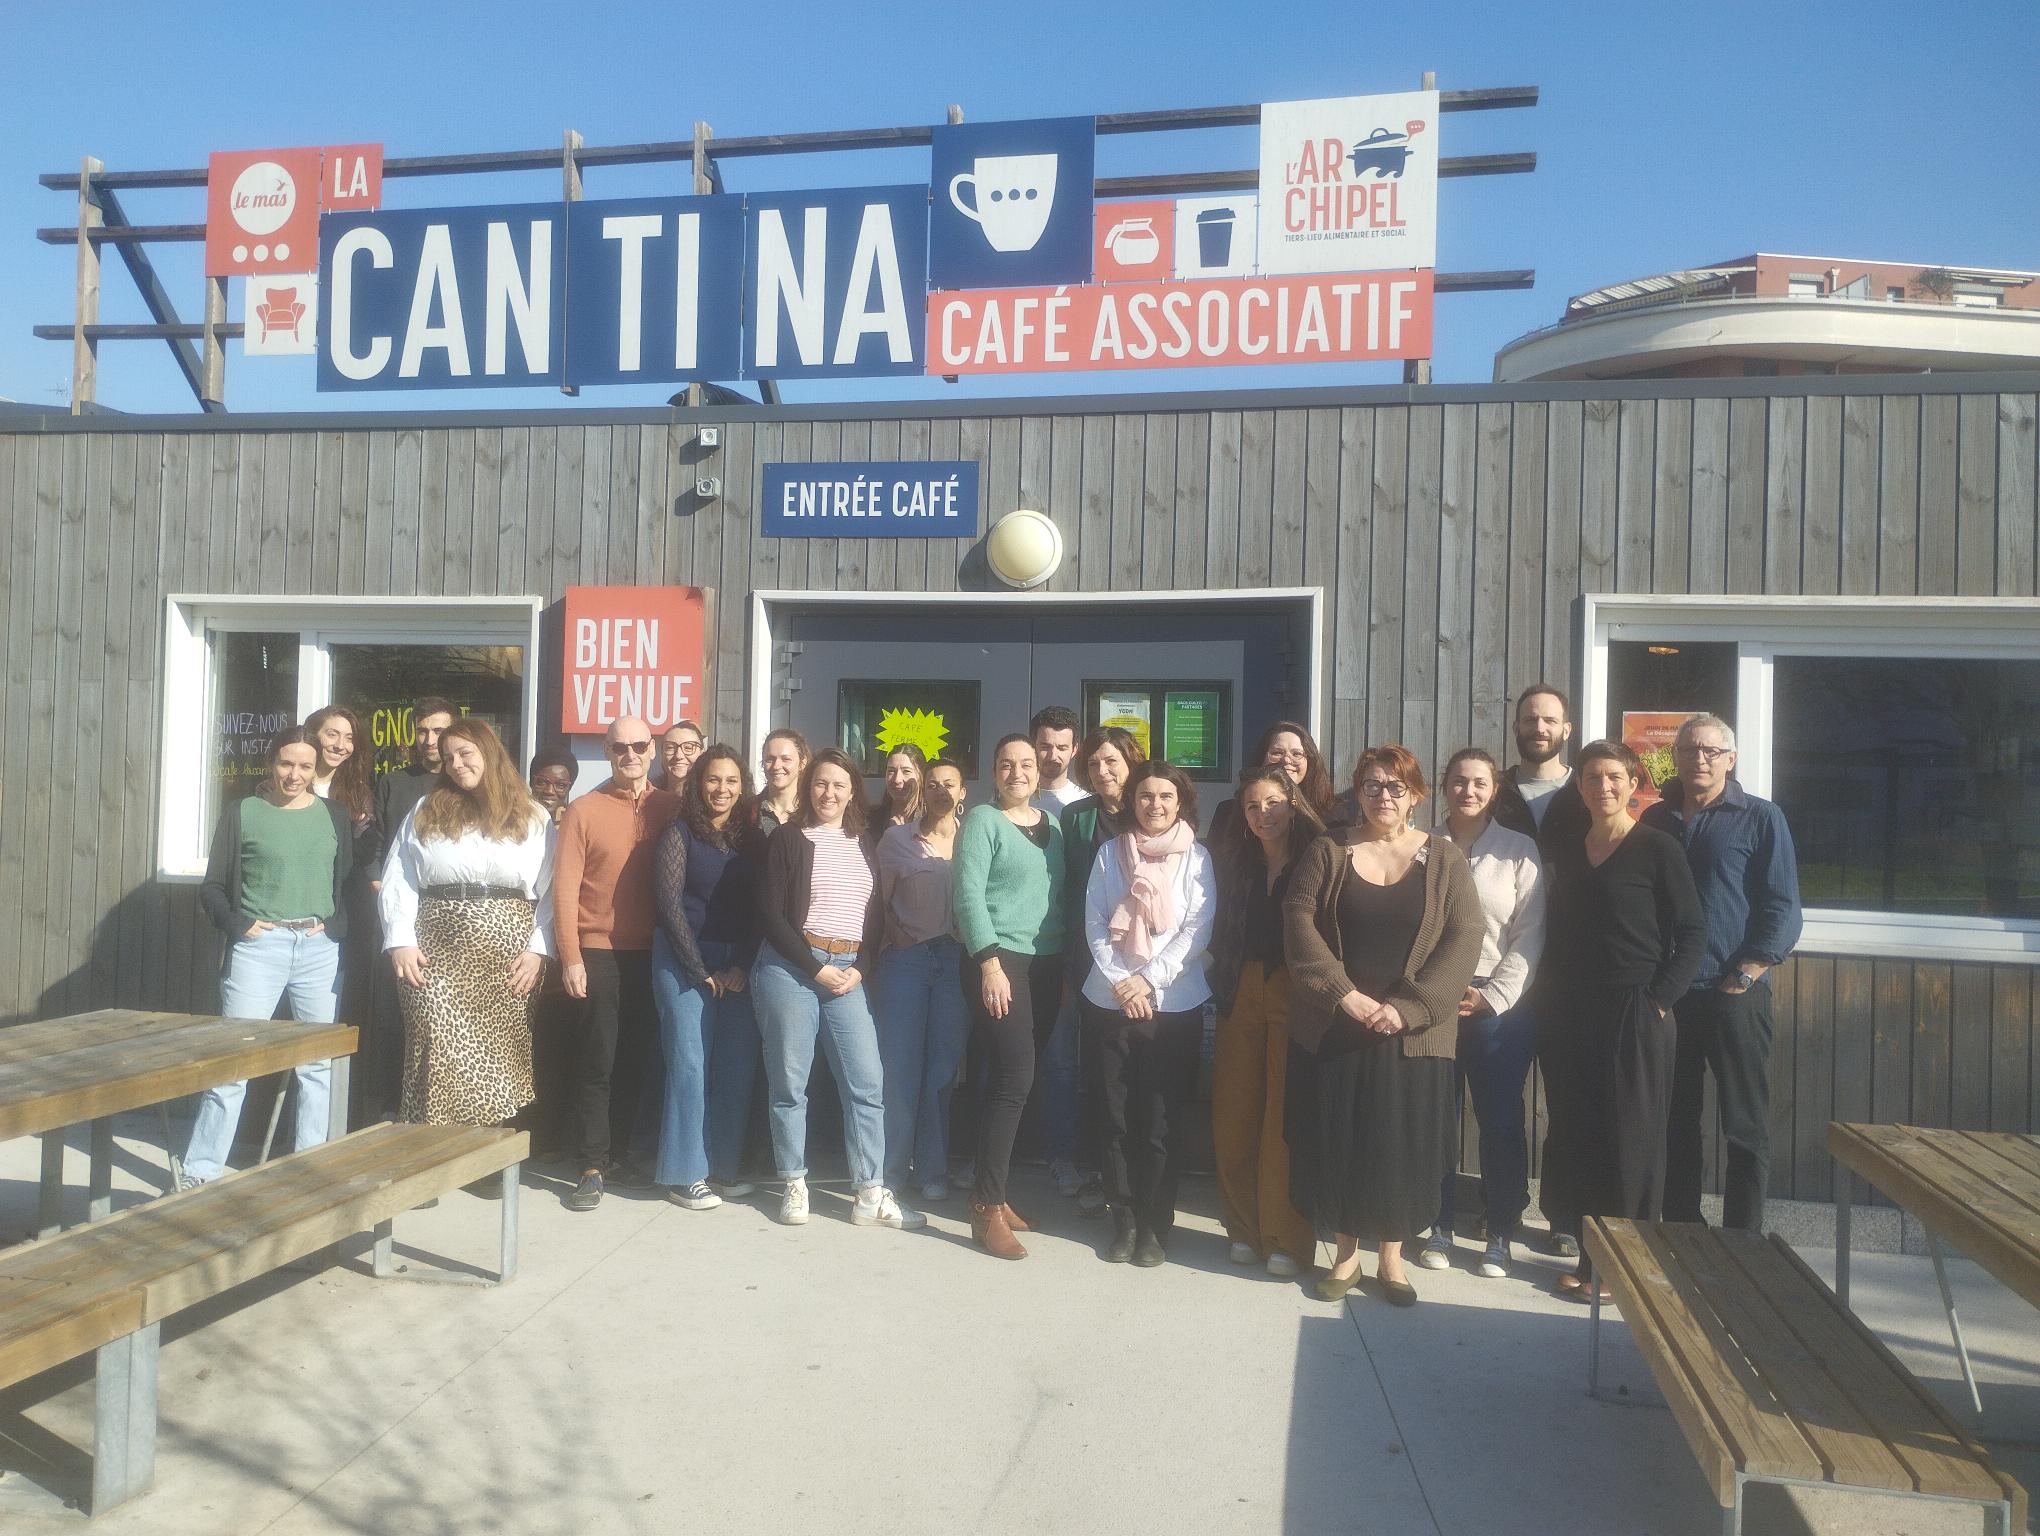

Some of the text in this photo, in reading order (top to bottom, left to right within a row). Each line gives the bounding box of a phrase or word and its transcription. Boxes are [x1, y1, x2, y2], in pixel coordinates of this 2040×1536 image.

[235, 192, 249, 209] le
[334, 156, 369, 198] LA
[1285, 182, 1407, 233] CHIPEL
[1285, 229, 1407, 243] TIERS-LIEU ALIMENTAIRE ET SOCIAL
[941, 280, 1417, 366] CAFÉ ASSOCIATIF
[783, 473, 960, 517] ENTRÉE CAFÉ
[575, 618, 659, 669] BIEN
[573, 674, 692, 726] VENUE
